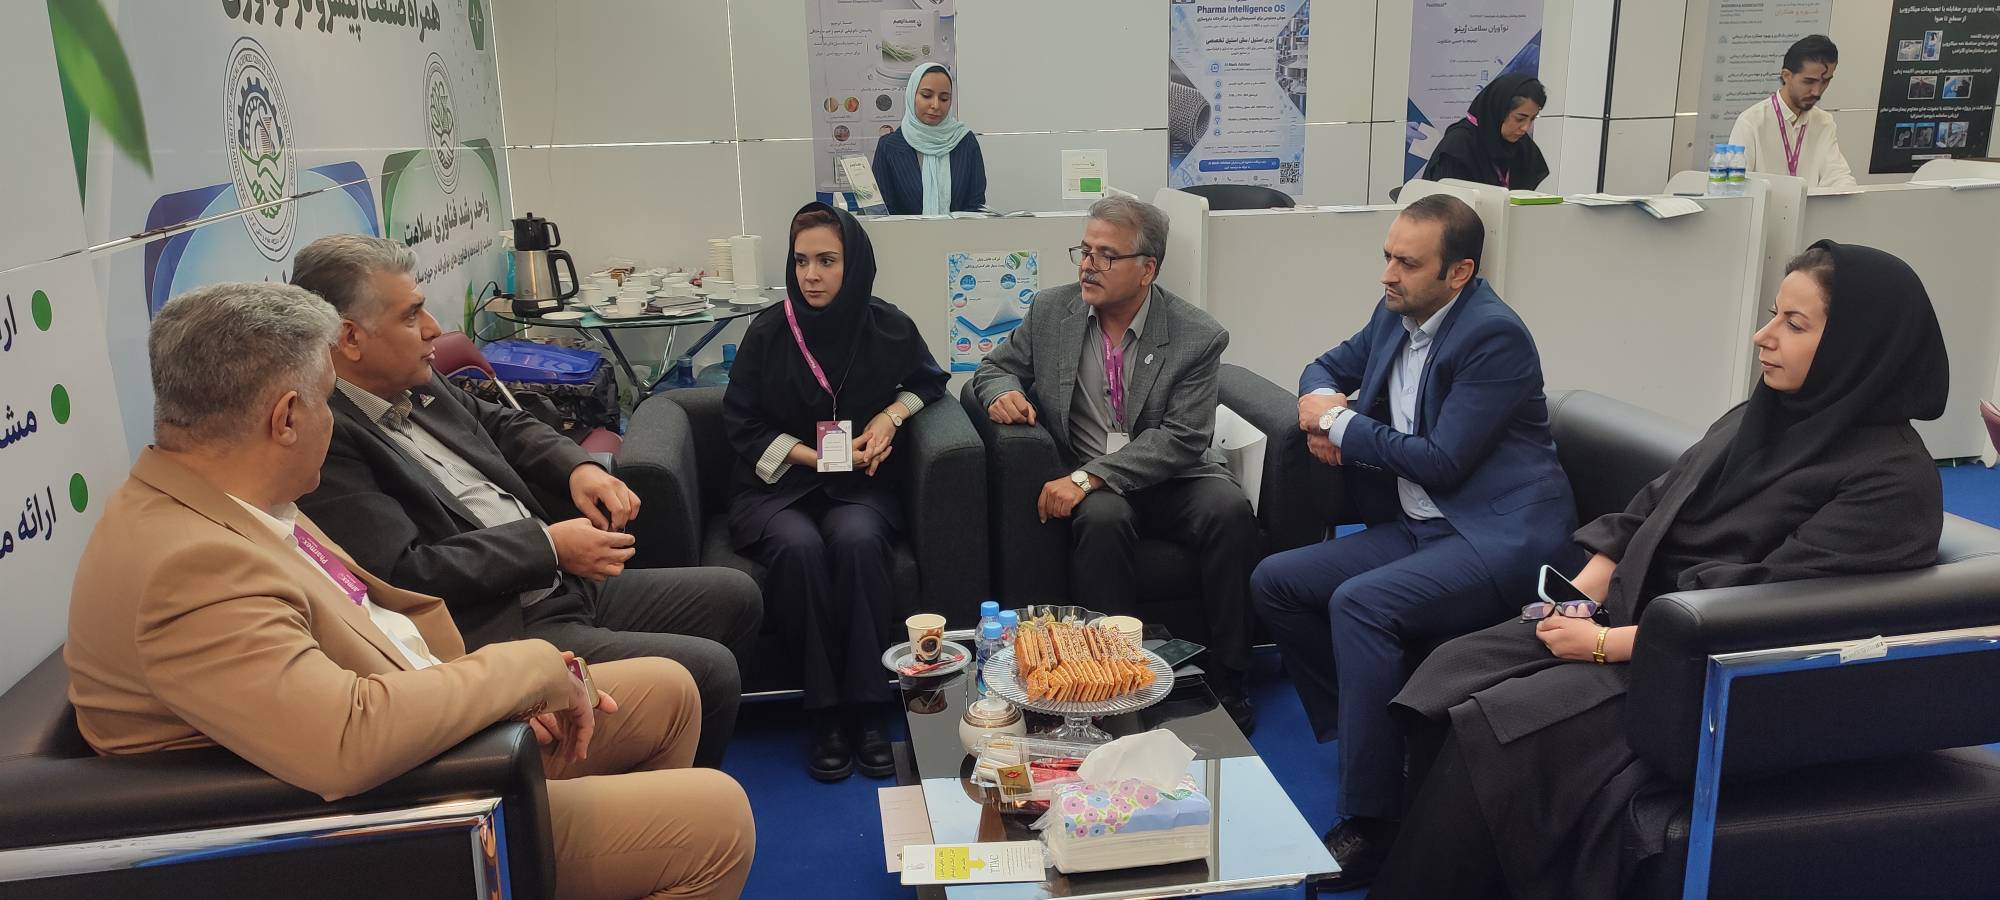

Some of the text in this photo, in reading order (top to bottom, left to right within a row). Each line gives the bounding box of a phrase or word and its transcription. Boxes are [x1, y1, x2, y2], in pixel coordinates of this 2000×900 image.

[1196, 4, 1286, 14] Pharma Intelligence OS
[1488, 24, 1509, 33] نوآوران
[404, 192, 490, 248] واحد رشد فناوری سلامت
[18, 485, 57, 541] ارائه
[303, 539, 329, 566] Pharmex
